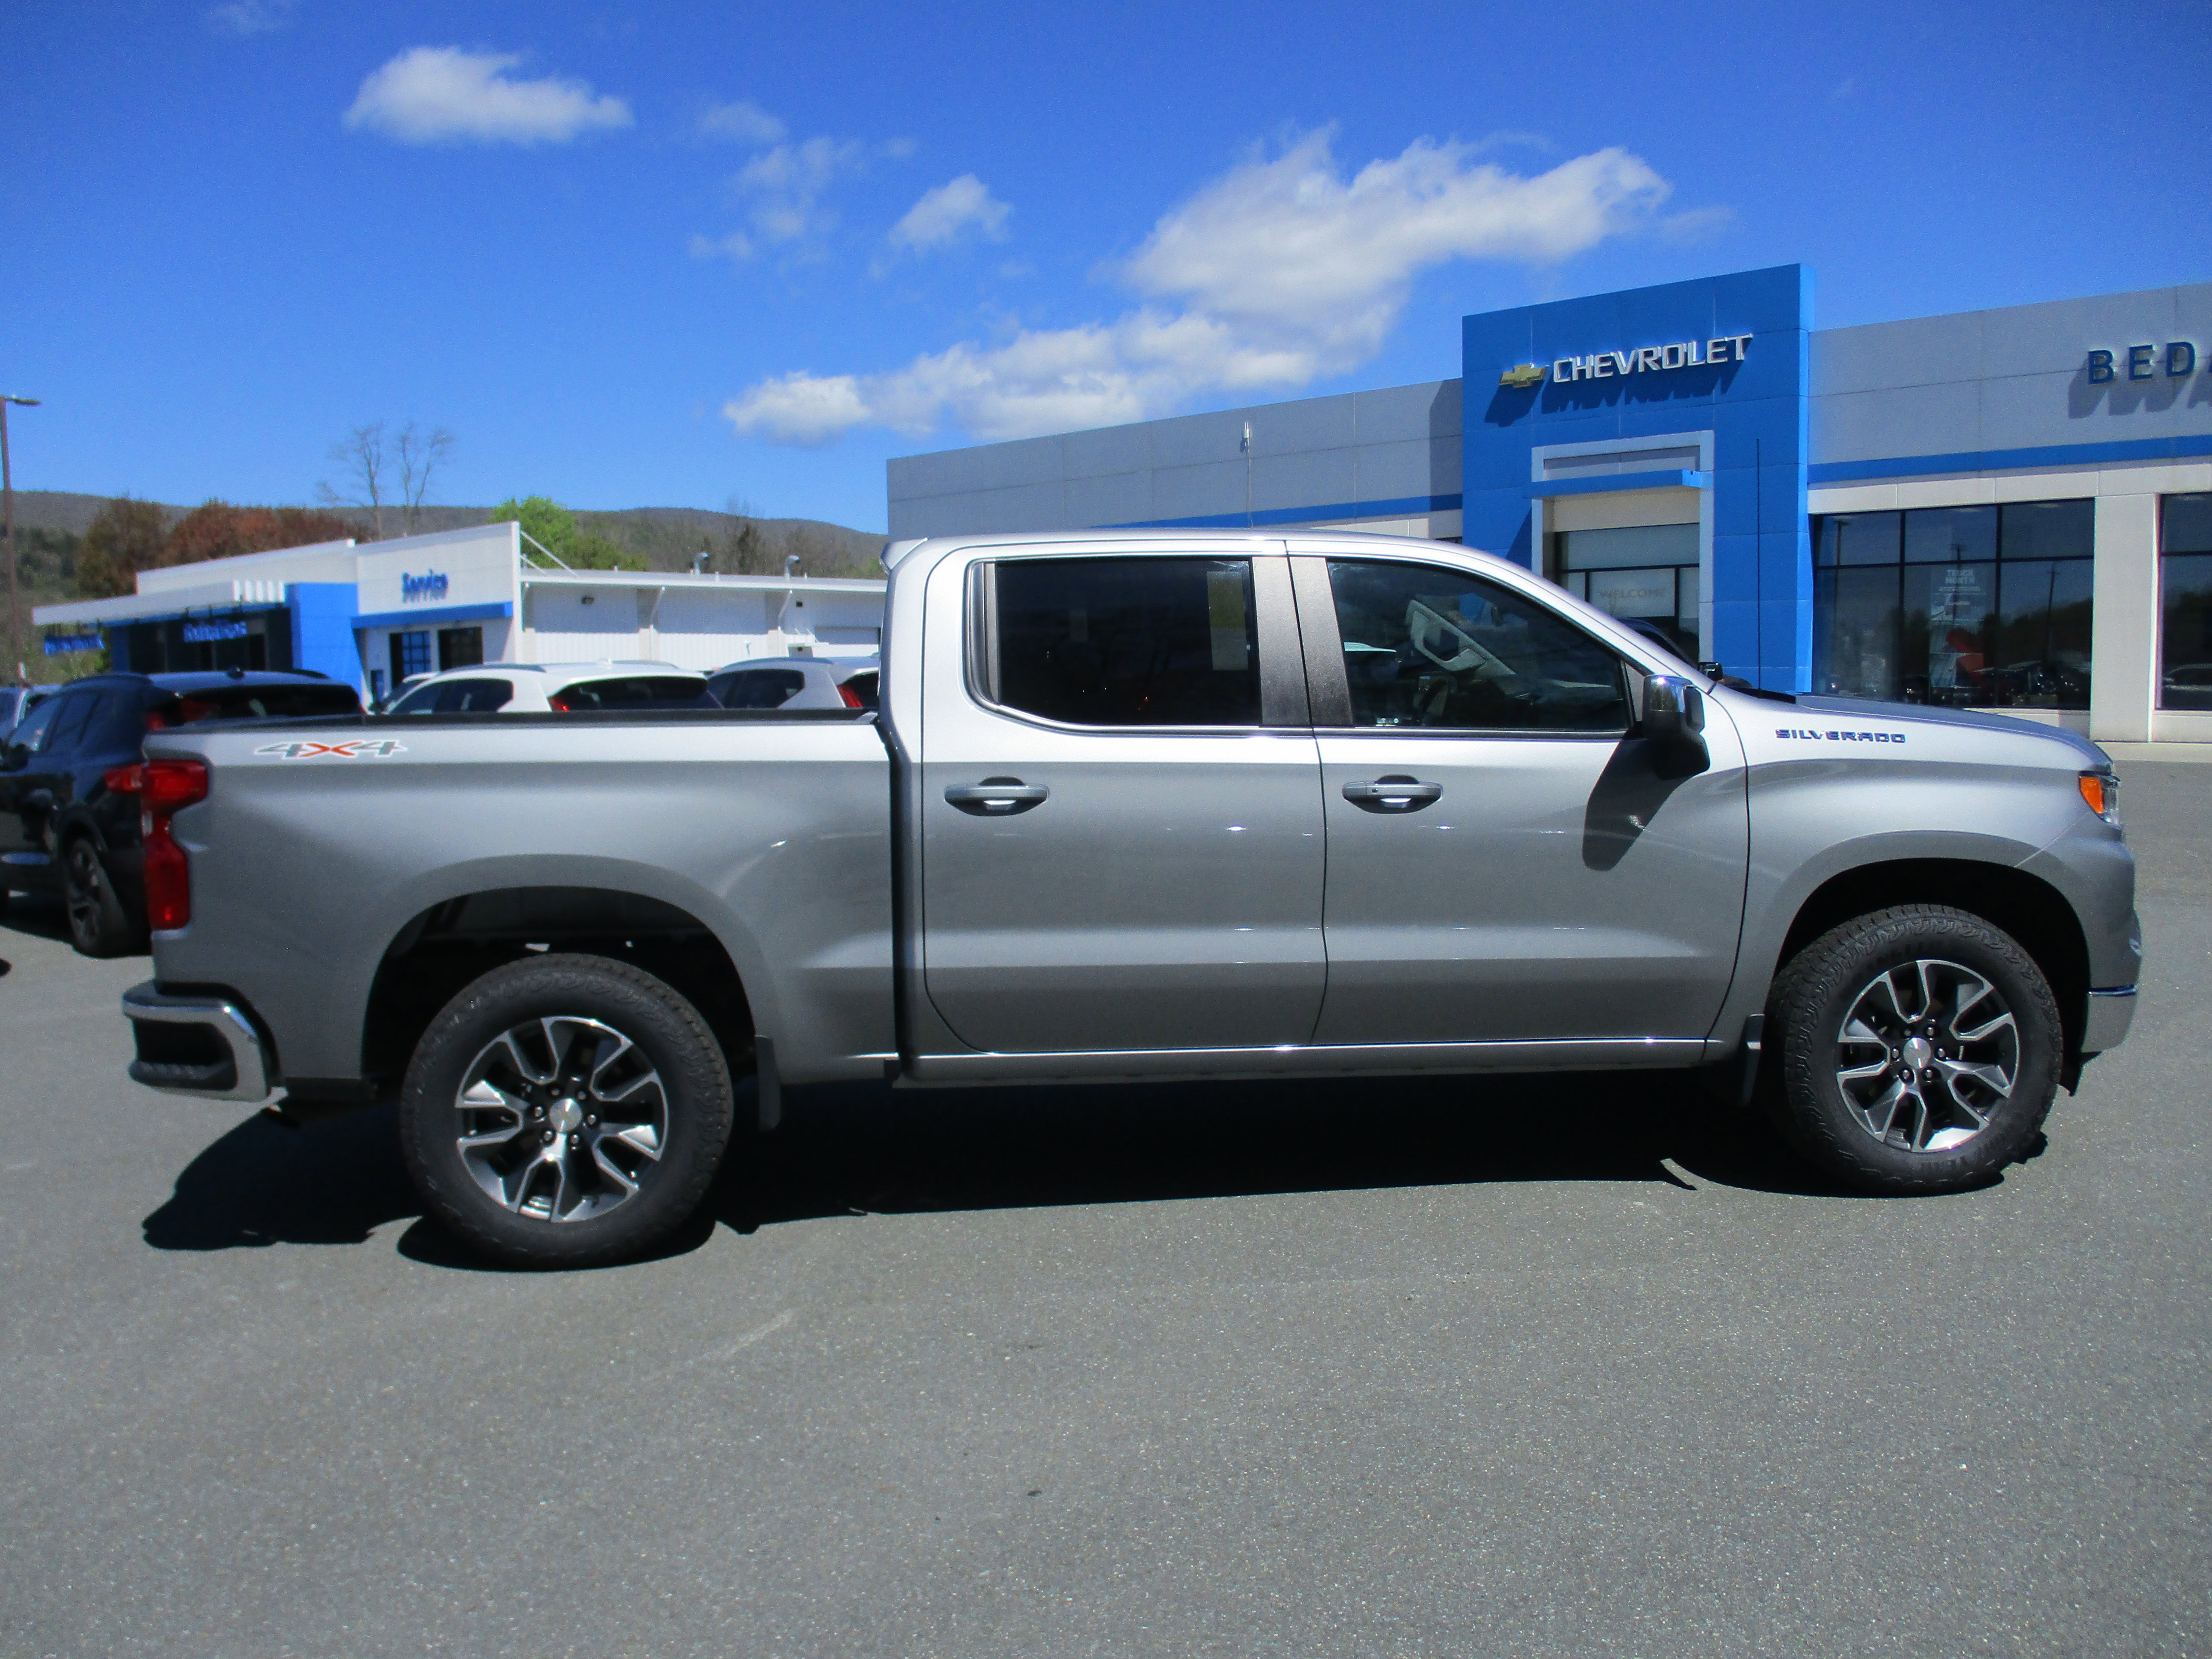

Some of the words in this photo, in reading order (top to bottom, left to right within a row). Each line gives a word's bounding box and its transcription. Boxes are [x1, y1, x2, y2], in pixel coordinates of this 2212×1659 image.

[1553, 333, 1753, 383] CHEVROLET
[2088, 341, 2212, 385] BED
[1598, 588, 1666, 599] WELCOME
[1776, 729, 1906, 743] SILVERADO
[255, 739, 408, 760] 4X4
